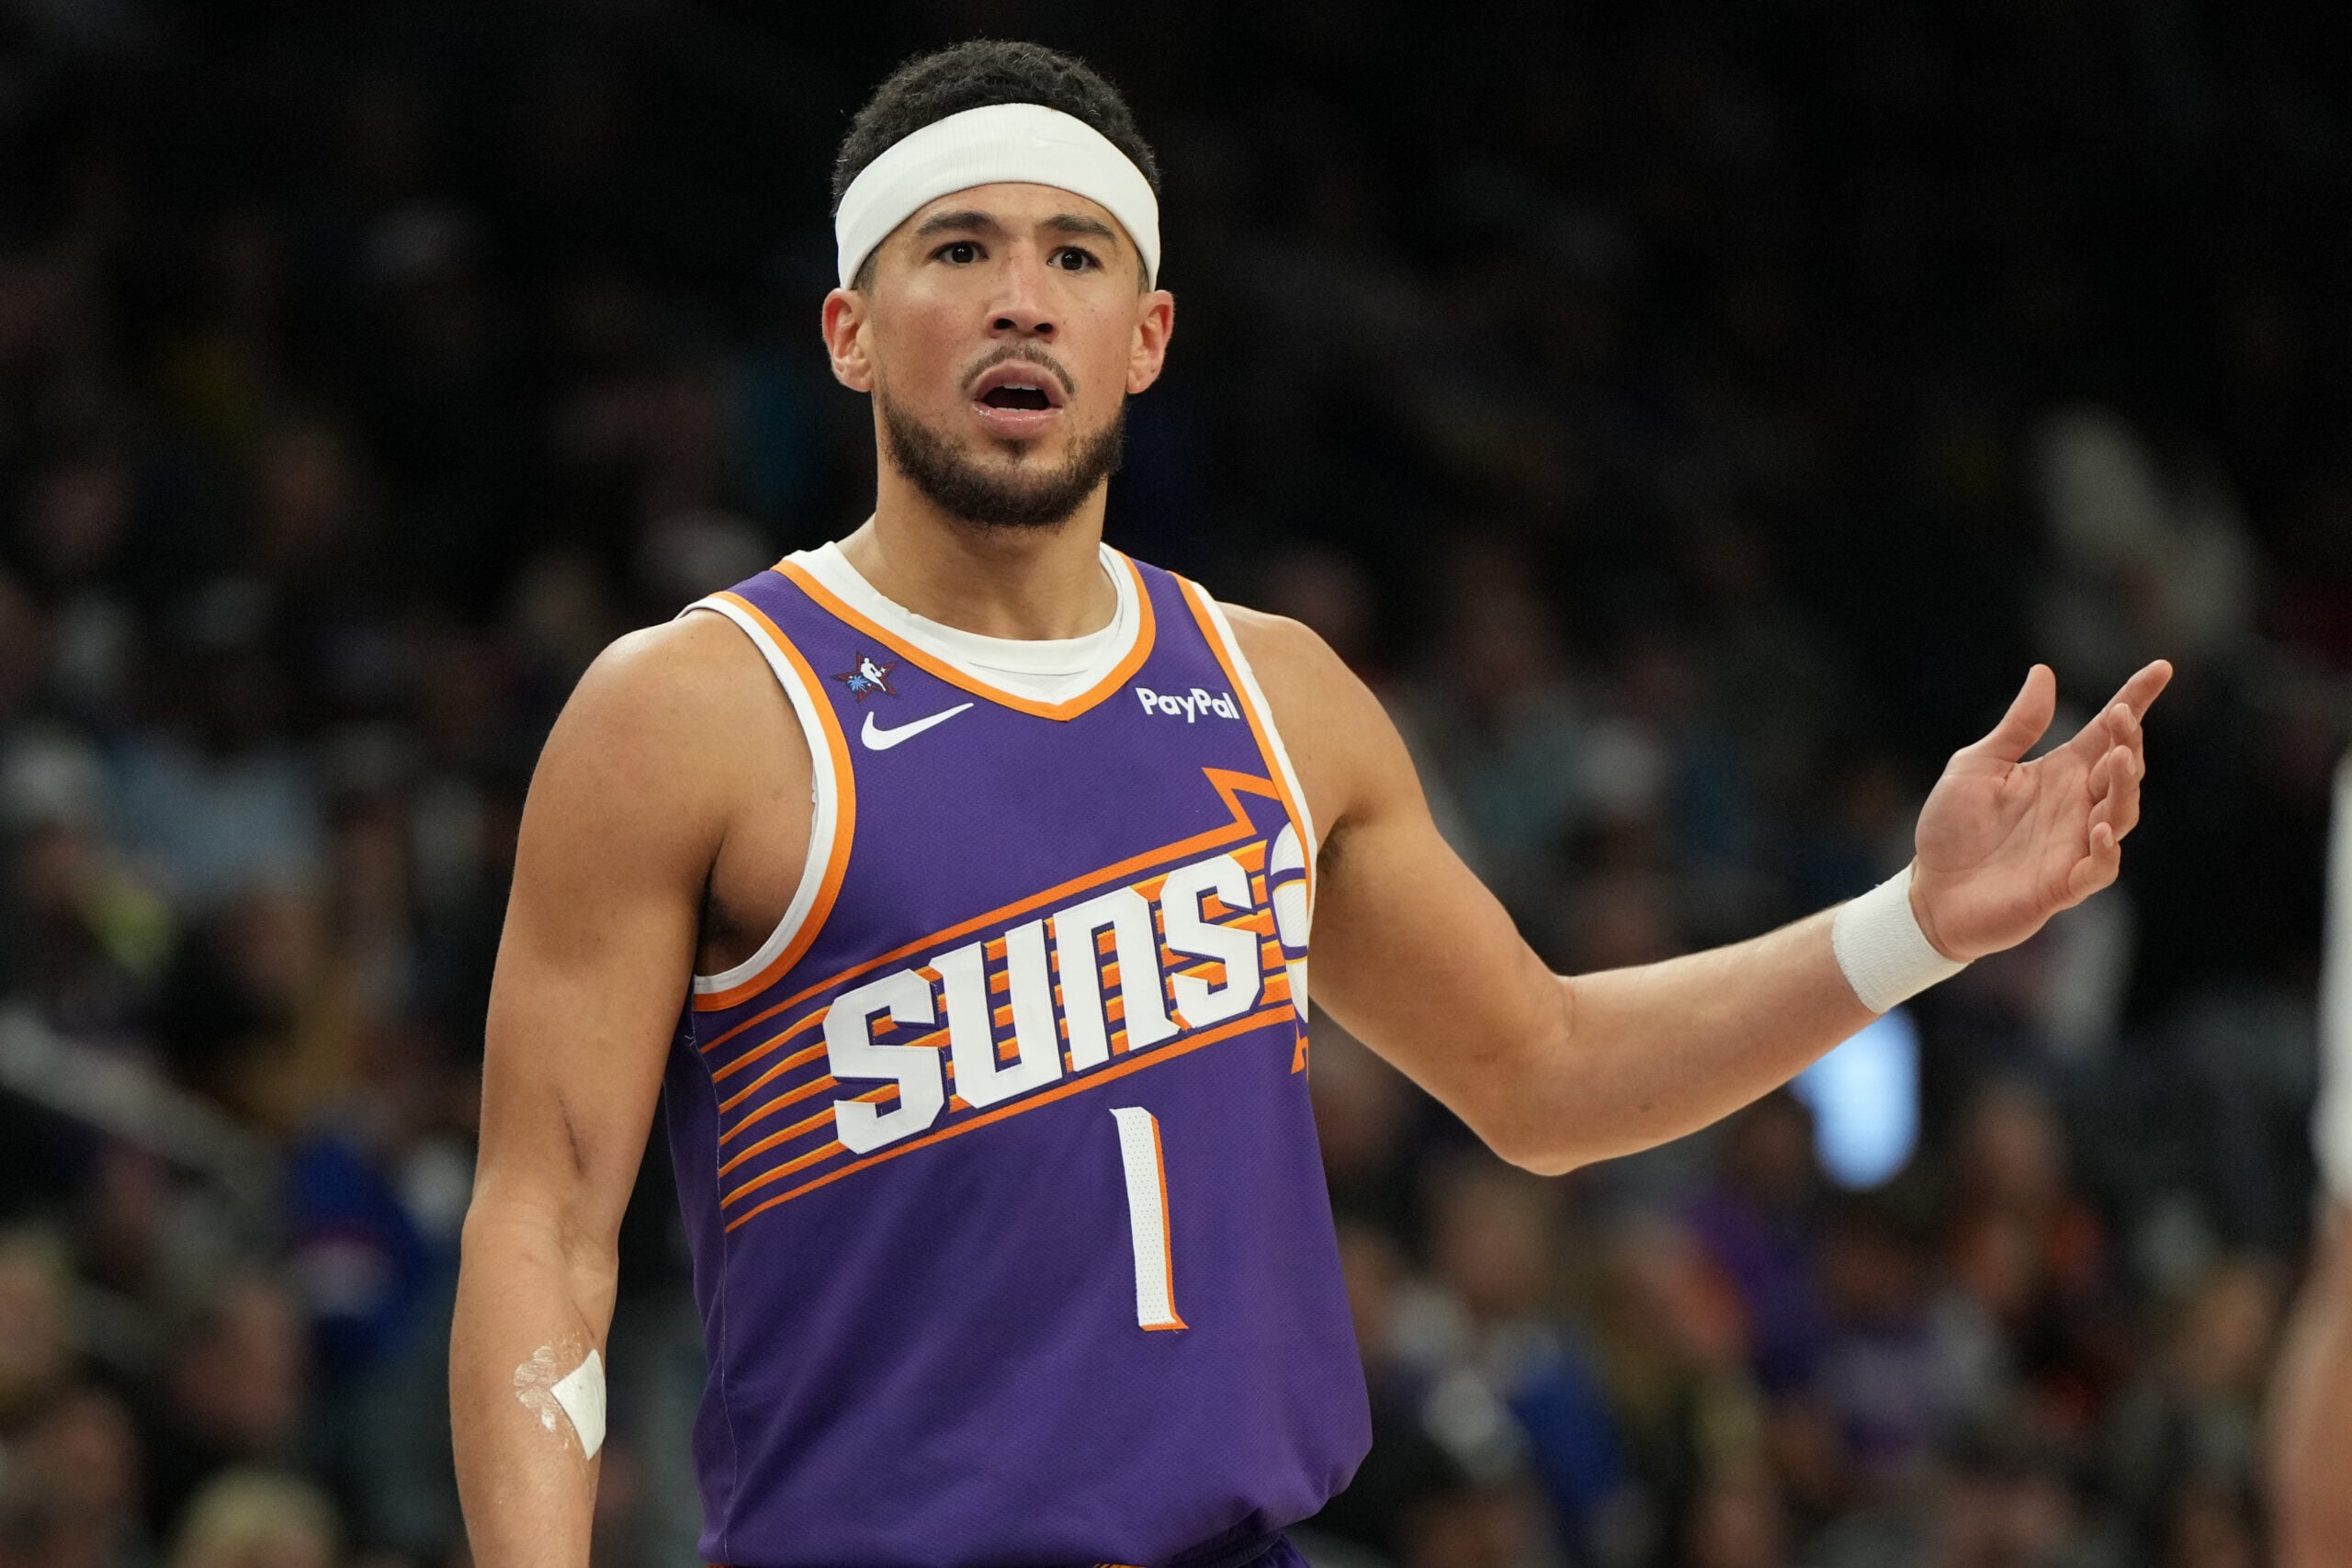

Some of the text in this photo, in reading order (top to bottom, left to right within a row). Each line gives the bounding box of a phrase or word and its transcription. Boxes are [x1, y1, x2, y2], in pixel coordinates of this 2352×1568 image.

[1135, 687, 1240, 724] PayPal
[822, 853, 1261, 1155] SUNS
[1109, 1106, 1188, 1332] 1
